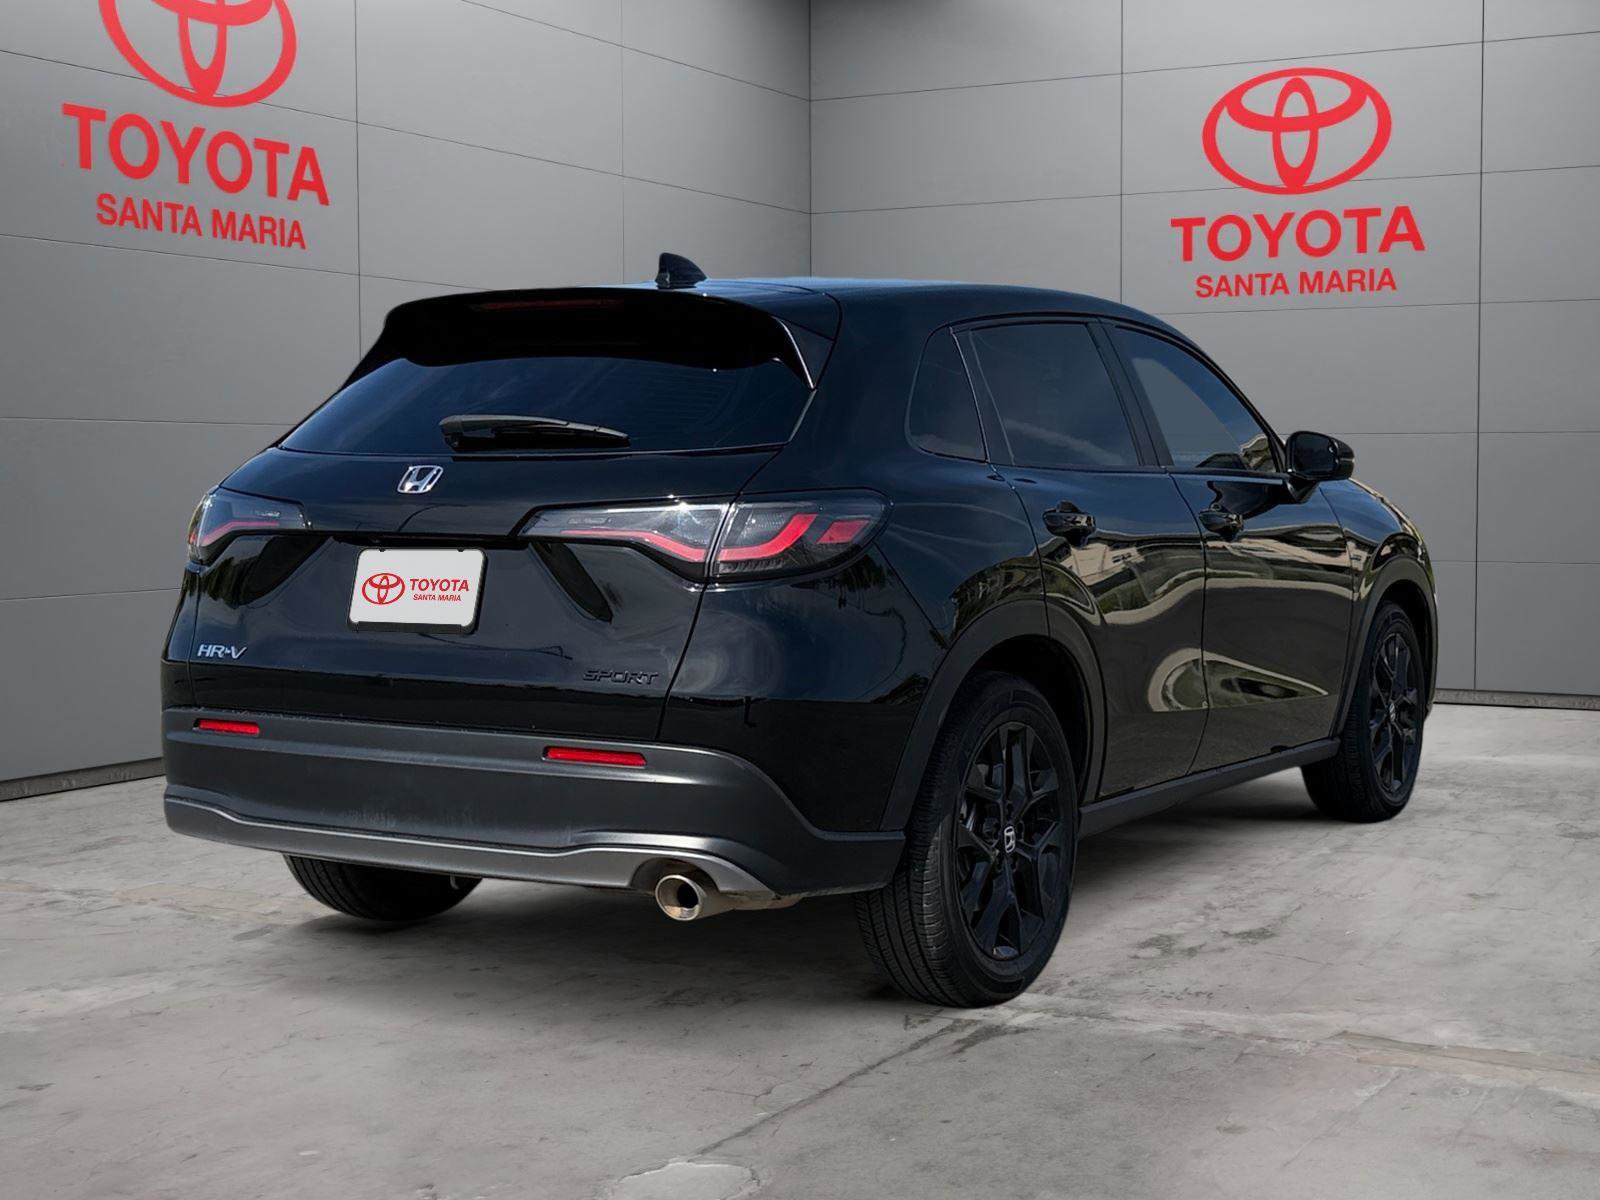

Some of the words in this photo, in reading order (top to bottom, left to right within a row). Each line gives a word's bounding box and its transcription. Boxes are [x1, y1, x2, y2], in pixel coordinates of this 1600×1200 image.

[62, 102, 330, 207] TOYOTA
[96, 193, 202, 237] SANTA
[211, 208, 307, 250] MARIA
[1169, 205, 1426, 263] TOYOTA
[1195, 272, 1290, 299] SANTA
[1298, 267, 1397, 295] MARIA
[409, 578, 470, 592] TOYOTA
[438, 594, 462, 602] MARIA
[197, 643, 248, 660] HR-V
[582, 669, 659, 686] SPORT
